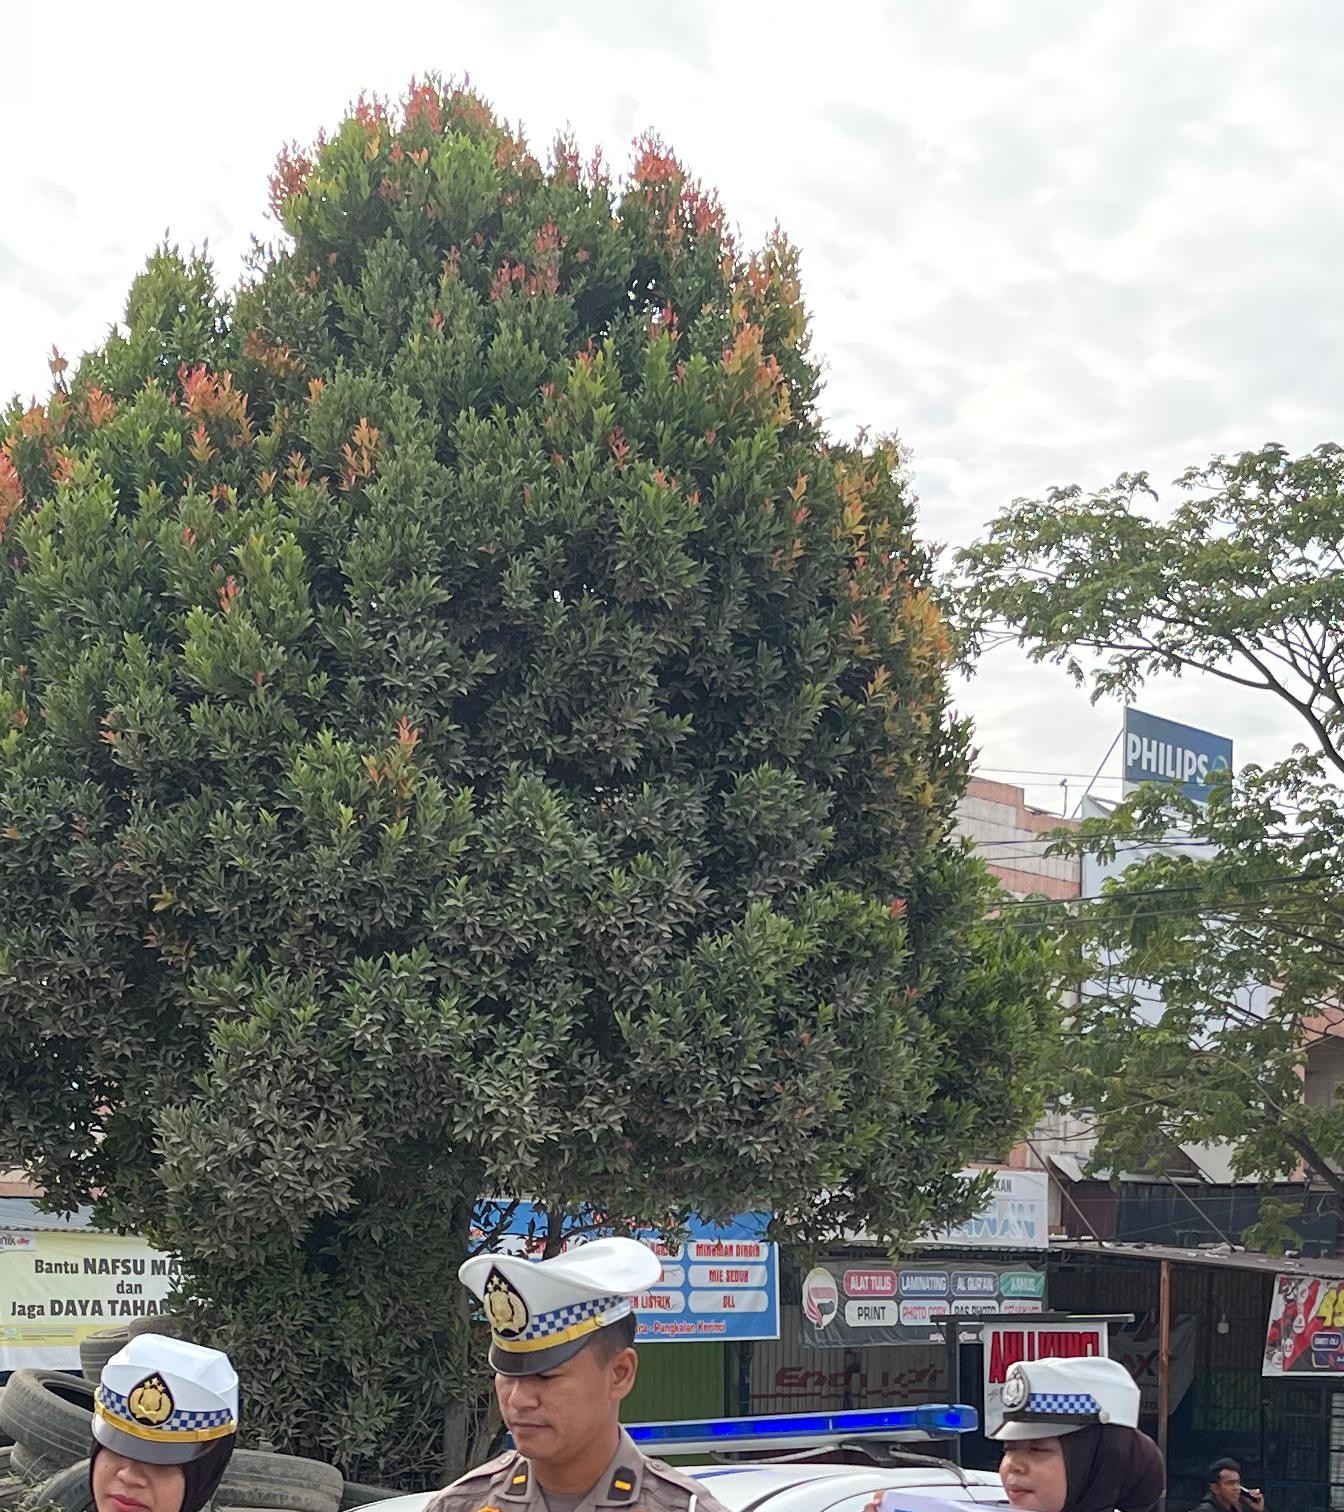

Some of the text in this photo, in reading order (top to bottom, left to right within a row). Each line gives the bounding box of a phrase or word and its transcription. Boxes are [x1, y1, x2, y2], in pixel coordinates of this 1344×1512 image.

[1127, 733, 1209, 786] PHILIPS
[35, 1258, 145, 1276] Bantu NAFSU
[116, 1279, 143, 1295] dan
[850, 1276, 892, 1291] ALAT TULIS
[901, 1276, 947, 1292] LAMINATING
[11, 1301, 45, 1319] Jaga
[50, 1300, 103, 1316] DAYA
[857, 1306, 886, 1320] PRINT
